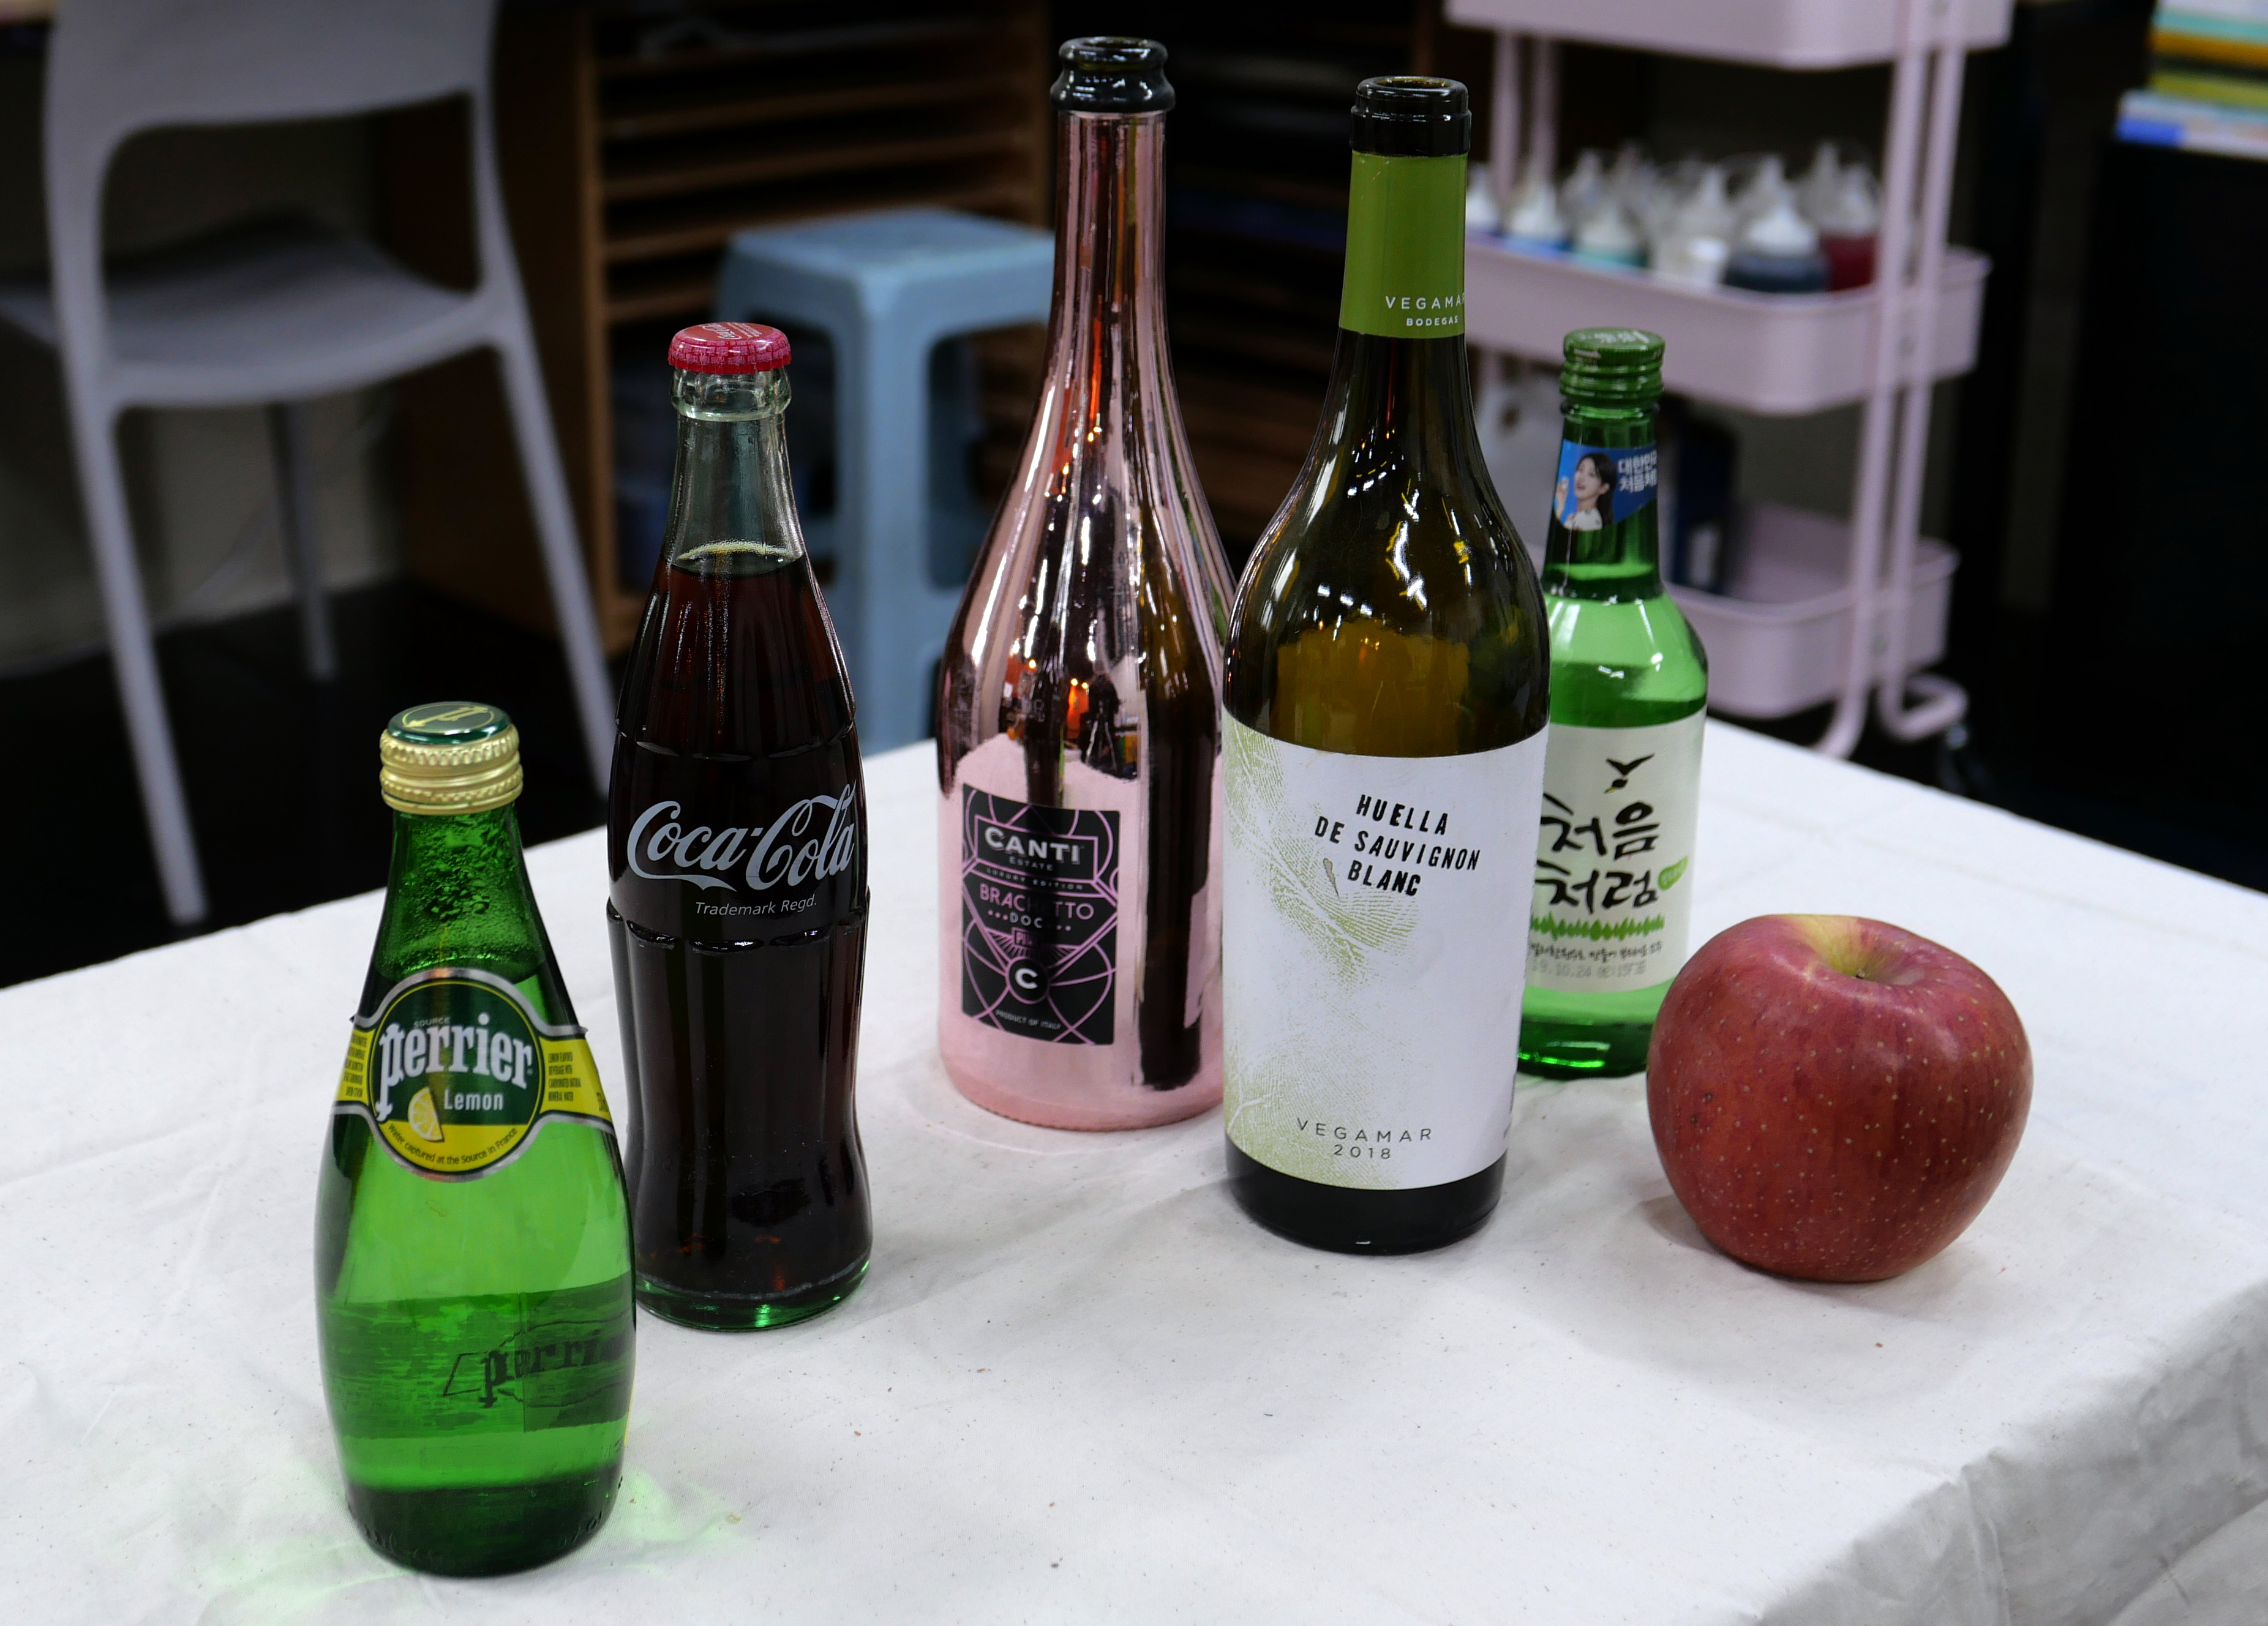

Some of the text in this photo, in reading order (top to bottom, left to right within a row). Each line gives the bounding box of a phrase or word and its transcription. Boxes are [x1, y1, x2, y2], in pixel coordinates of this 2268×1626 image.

[1406, 315, 1459, 326] BODEGAS
[1356, 794, 1448, 835] HUELLA
[1541, 793, 1661, 861] 처음
[627, 781, 857, 892] Coca-Cola
[985, 826, 1081, 865] CANTI
[1315, 815, 1481, 871] DE SAUVIGNON
[1009, 855, 1053, 872] ESTATE
[986, 867, 1083, 891] LUXURY EDITION
[1348, 860, 1421, 896] BLANC
[1535, 859, 1659, 915] 처럼
[696, 894, 817, 916] Trademark Regd.
[980, 883, 1095, 920] BRACTTO
[1009, 912, 1043, 929] DOC
[1015, 967, 1039, 990] C
[413, 1016, 451, 1028] SOURCE
[995, 1009, 1027, 1024] PRODUCT
[375, 1012, 533, 1122] perrier
[444, 1087, 504, 1111] Lemon
[1297, 1117, 1432, 1143] VEGAMAR
[388, 1123, 518, 1164] Water captured at the Source in France
[1333, 1144, 1391, 1160] 2018
